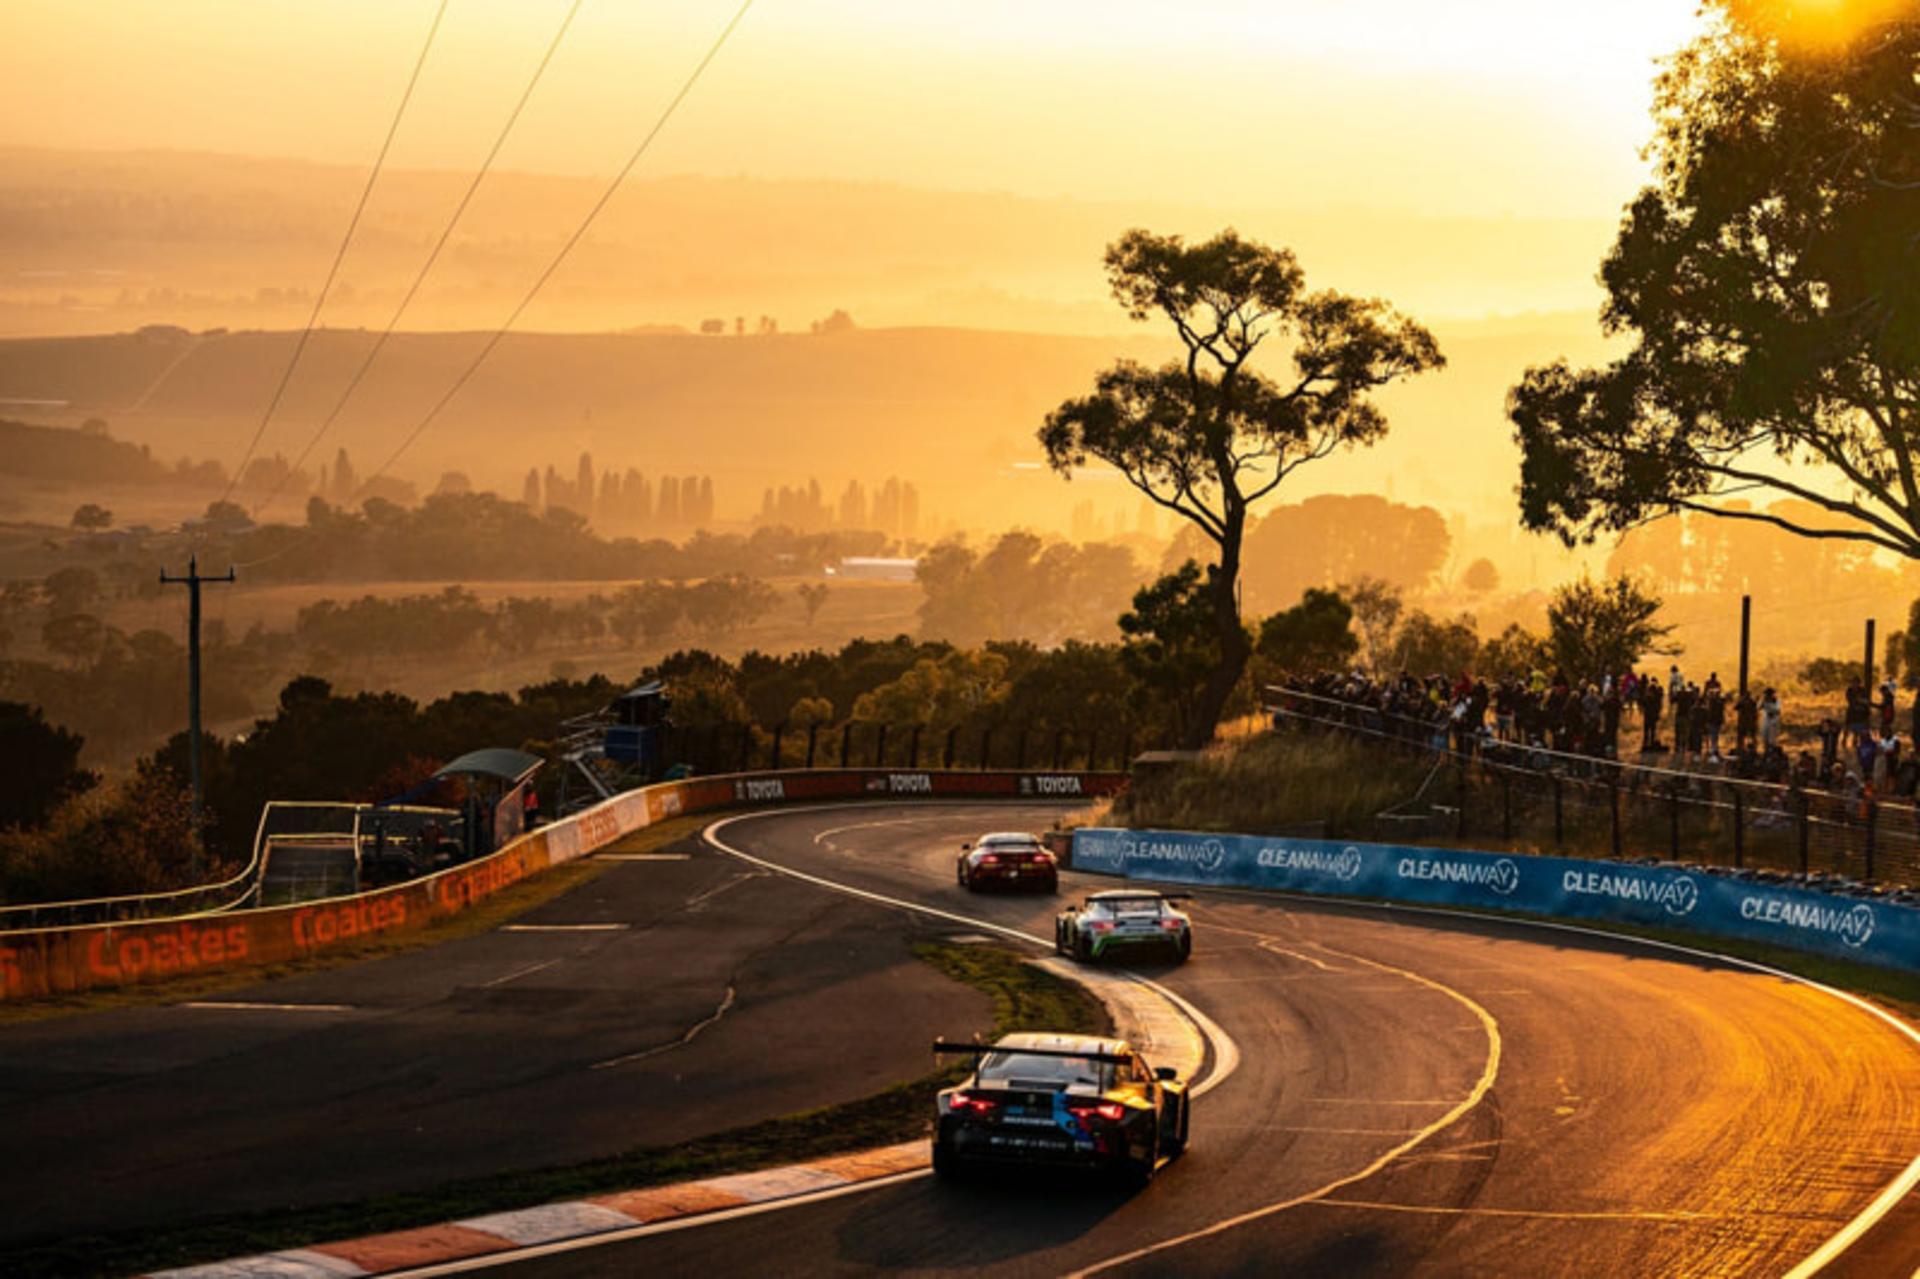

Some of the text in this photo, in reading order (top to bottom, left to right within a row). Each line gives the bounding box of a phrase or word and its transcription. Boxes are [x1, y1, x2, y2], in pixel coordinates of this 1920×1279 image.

[747, 780, 785, 799] TOYOTA
[889, 774, 932, 793] TOYOTA
[1036, 776, 1082, 794] TOYOTA
[1257, 848, 1358, 876] CLEANAWAY
[1398, 858, 1512, 889] CLEANAWAY
[1563, 869, 1689, 907] CLEANAWAY
[291, 895, 405, 946] Coates
[1741, 897, 1865, 936] CLEANAWAY
[88, 921, 249, 976] Coates
